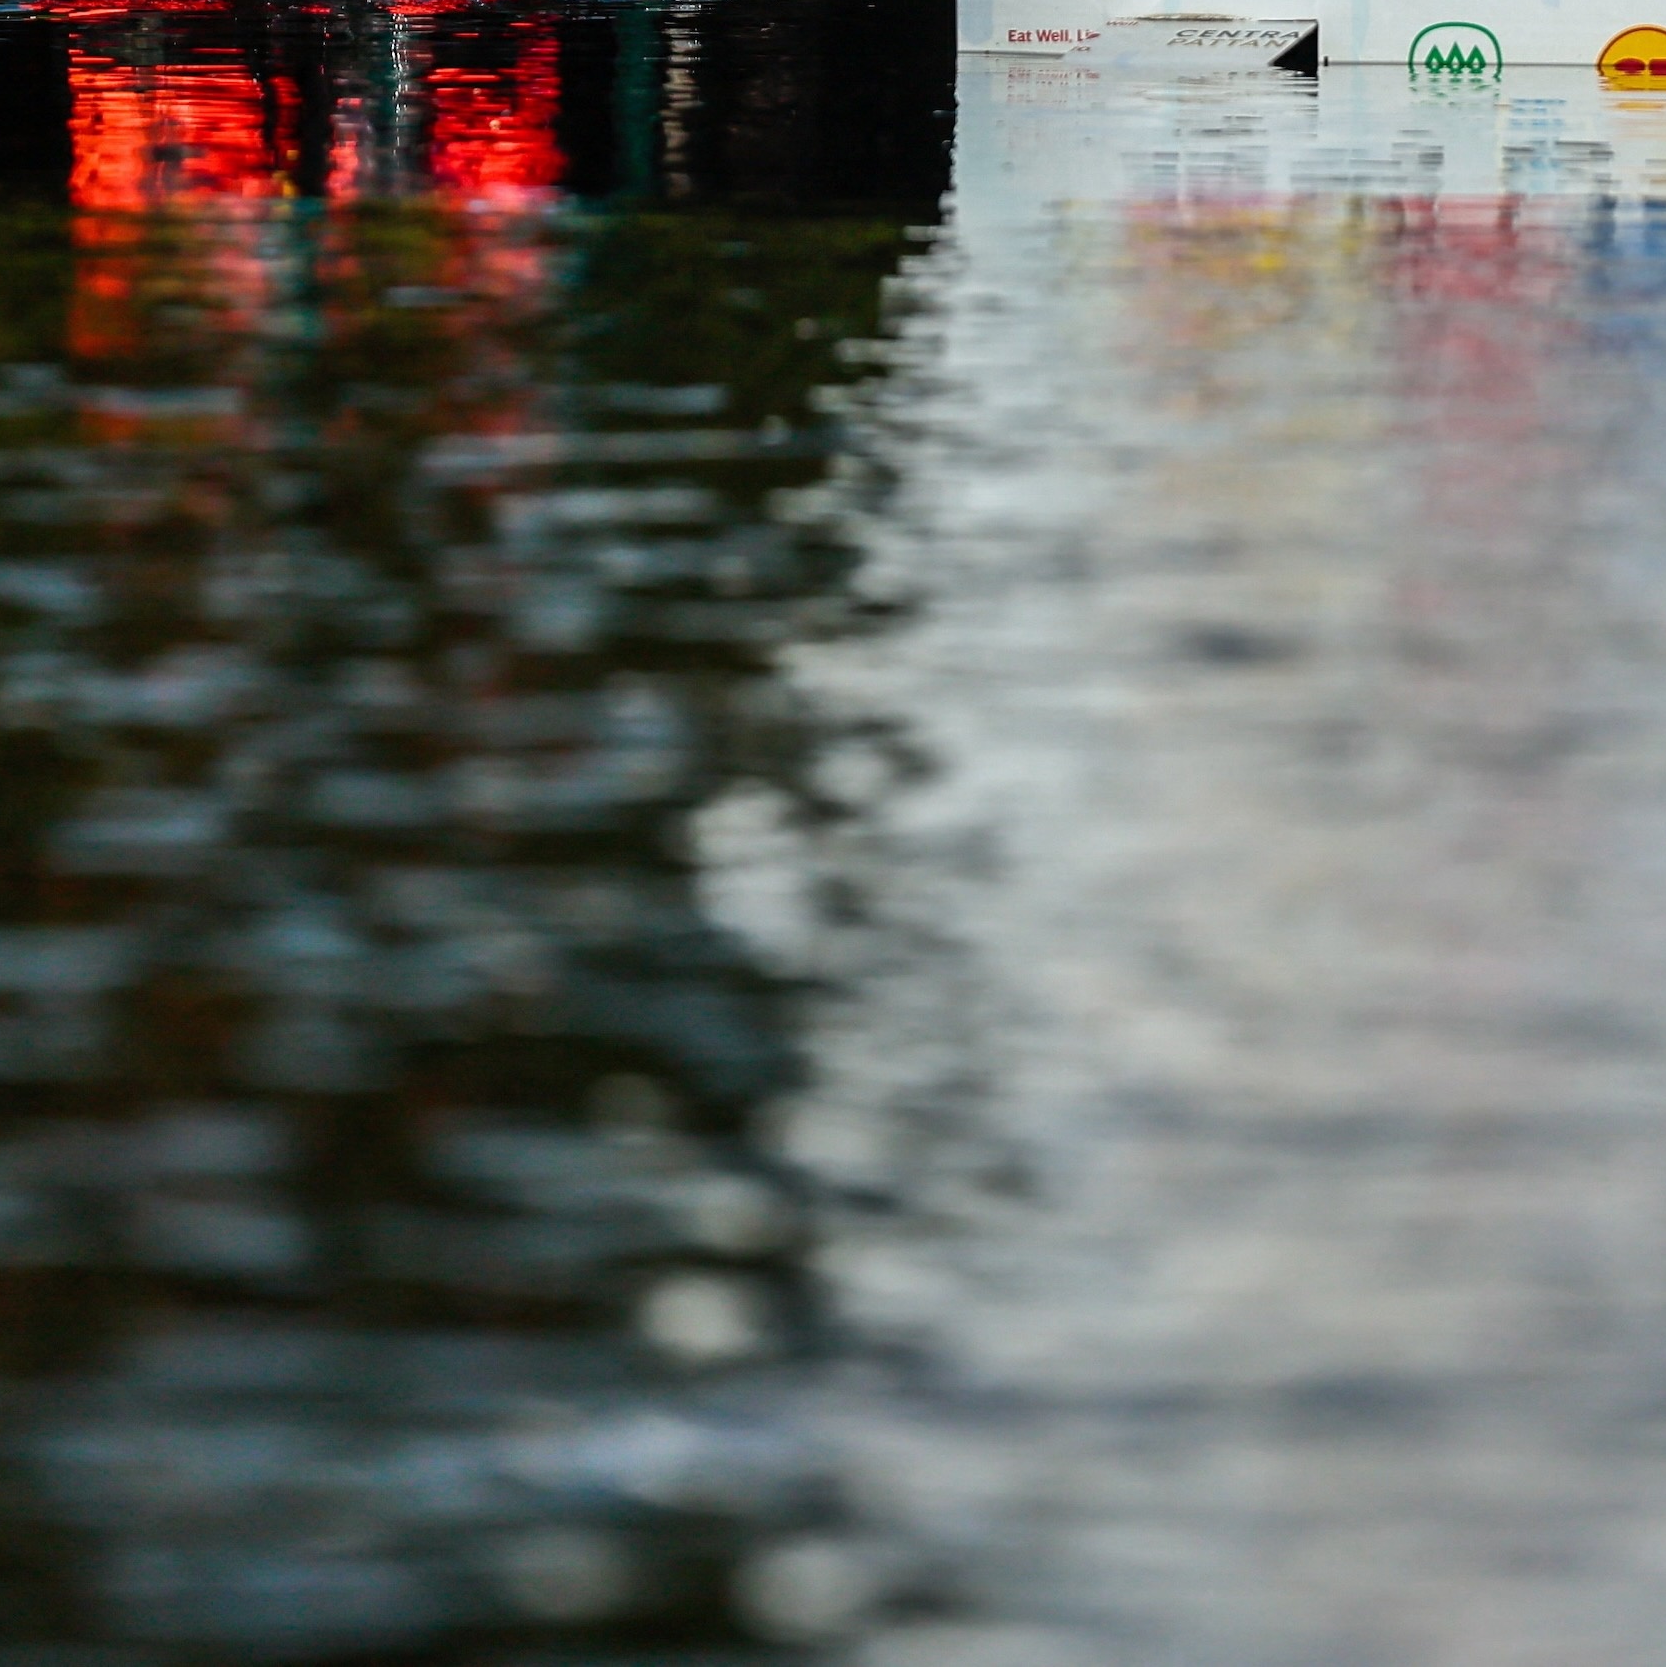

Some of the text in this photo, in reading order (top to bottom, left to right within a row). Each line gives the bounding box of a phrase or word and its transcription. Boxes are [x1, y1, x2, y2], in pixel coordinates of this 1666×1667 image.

[1007, 29, 1032, 42] Eat
[1175, 29, 1301, 39] CENTRA
[1167, 38, 1287, 47] PATTAN
